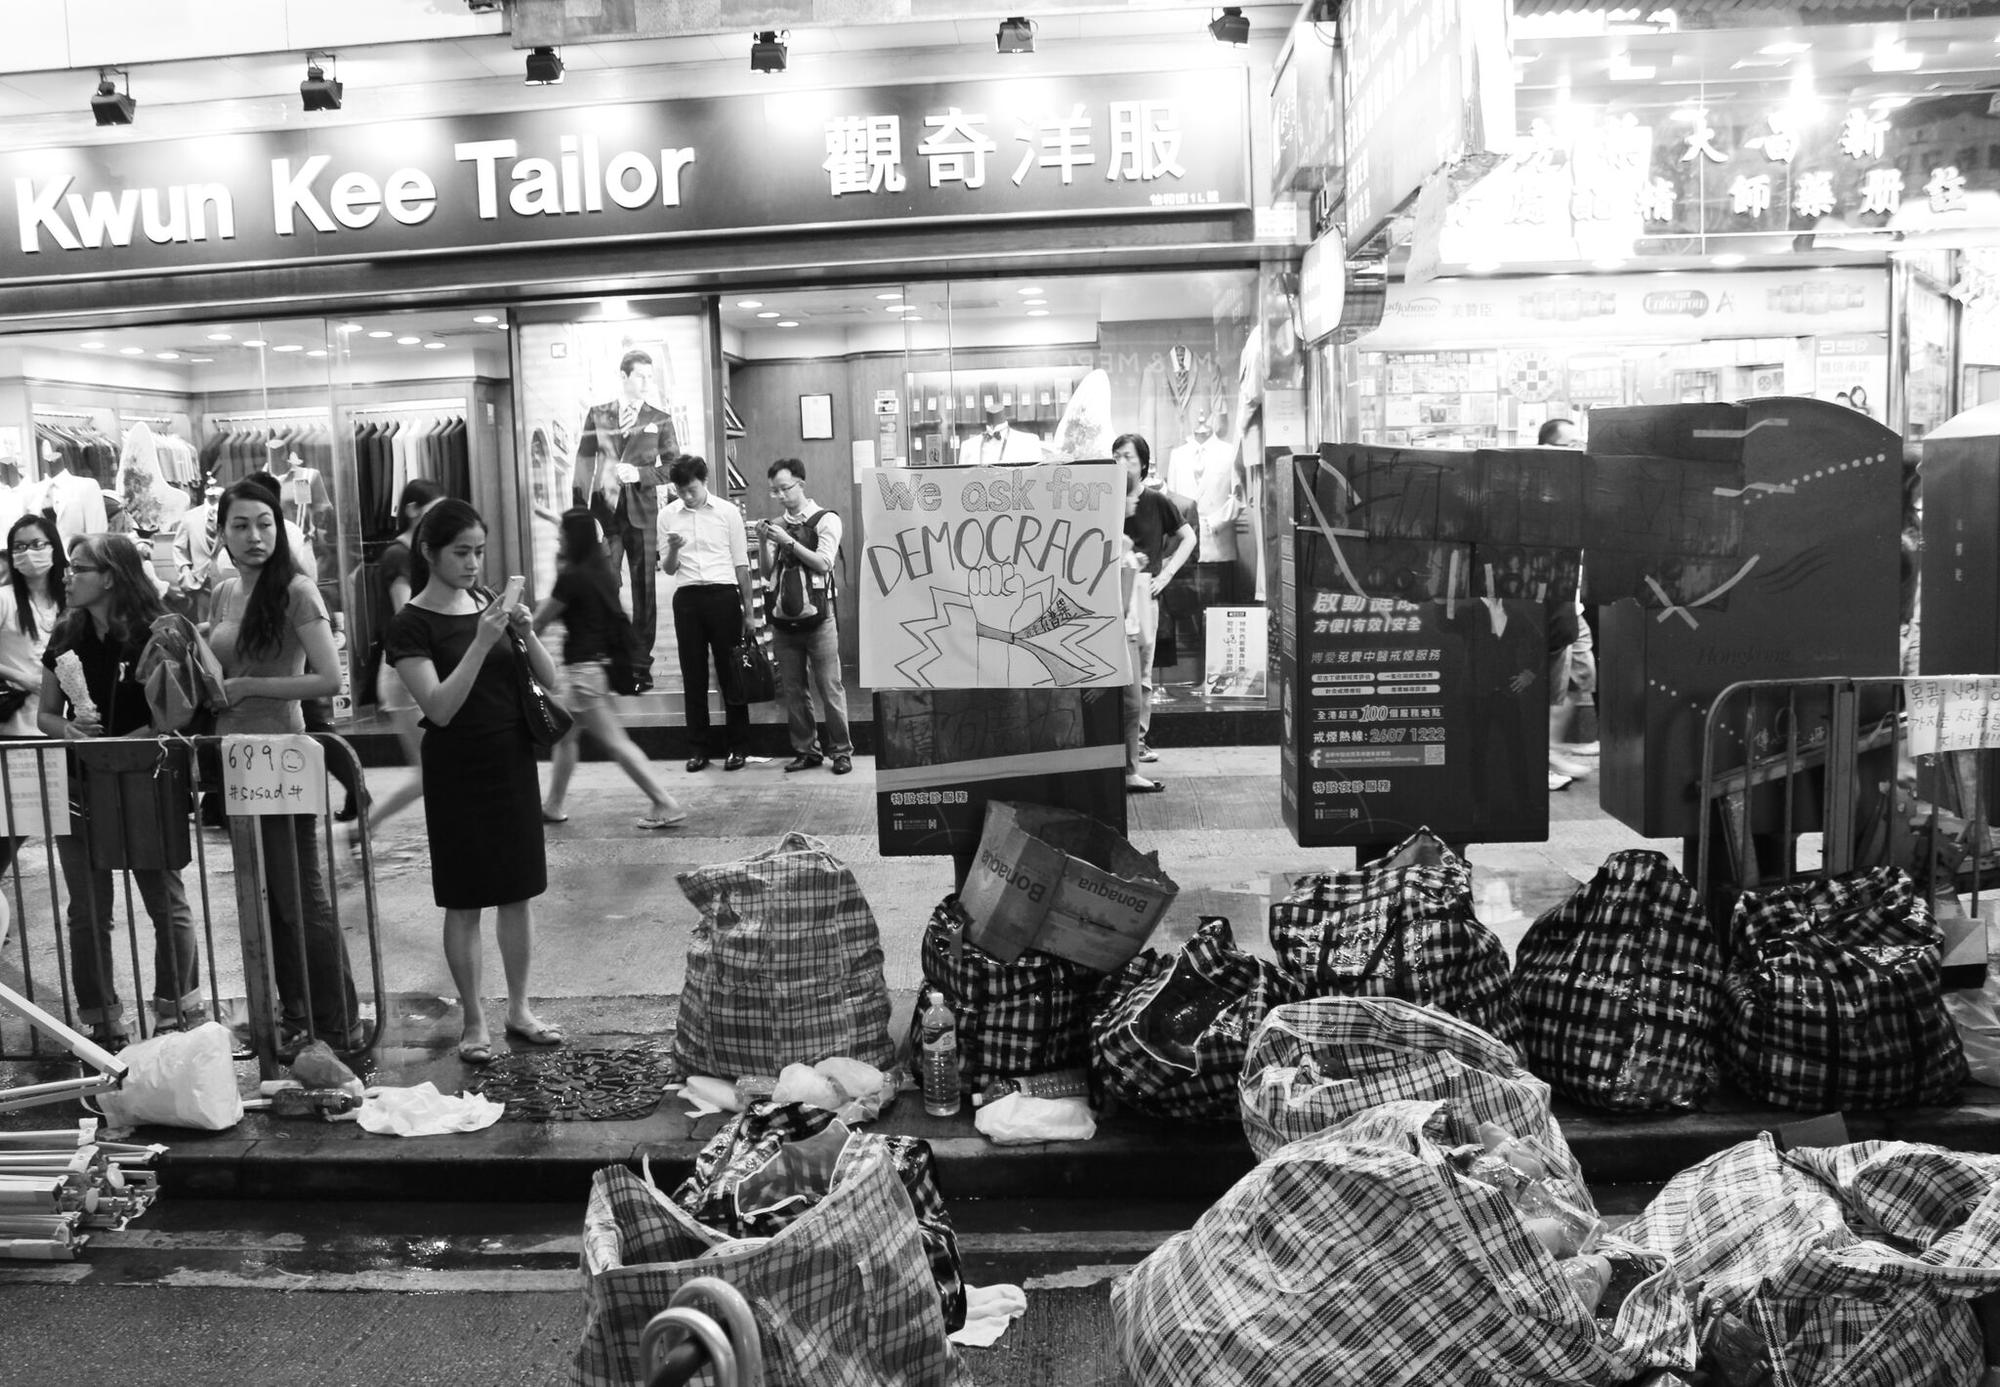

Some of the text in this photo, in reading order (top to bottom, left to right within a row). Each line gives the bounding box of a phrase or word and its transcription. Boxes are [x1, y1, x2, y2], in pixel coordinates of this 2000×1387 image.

[822, 100, 1187, 196] 觀奇洋服
[14, 134, 696, 252] Kwun Kee Tailor
[876, 467, 1112, 513] We ask for
[867, 514, 1119, 597] DEMOCRACY
[228, 743, 274, 771] 689
[1409, 727, 1446, 743] 1222
[981, 848, 1047, 905] Bonaqua
[1077, 876, 1149, 914] Bonaqua
